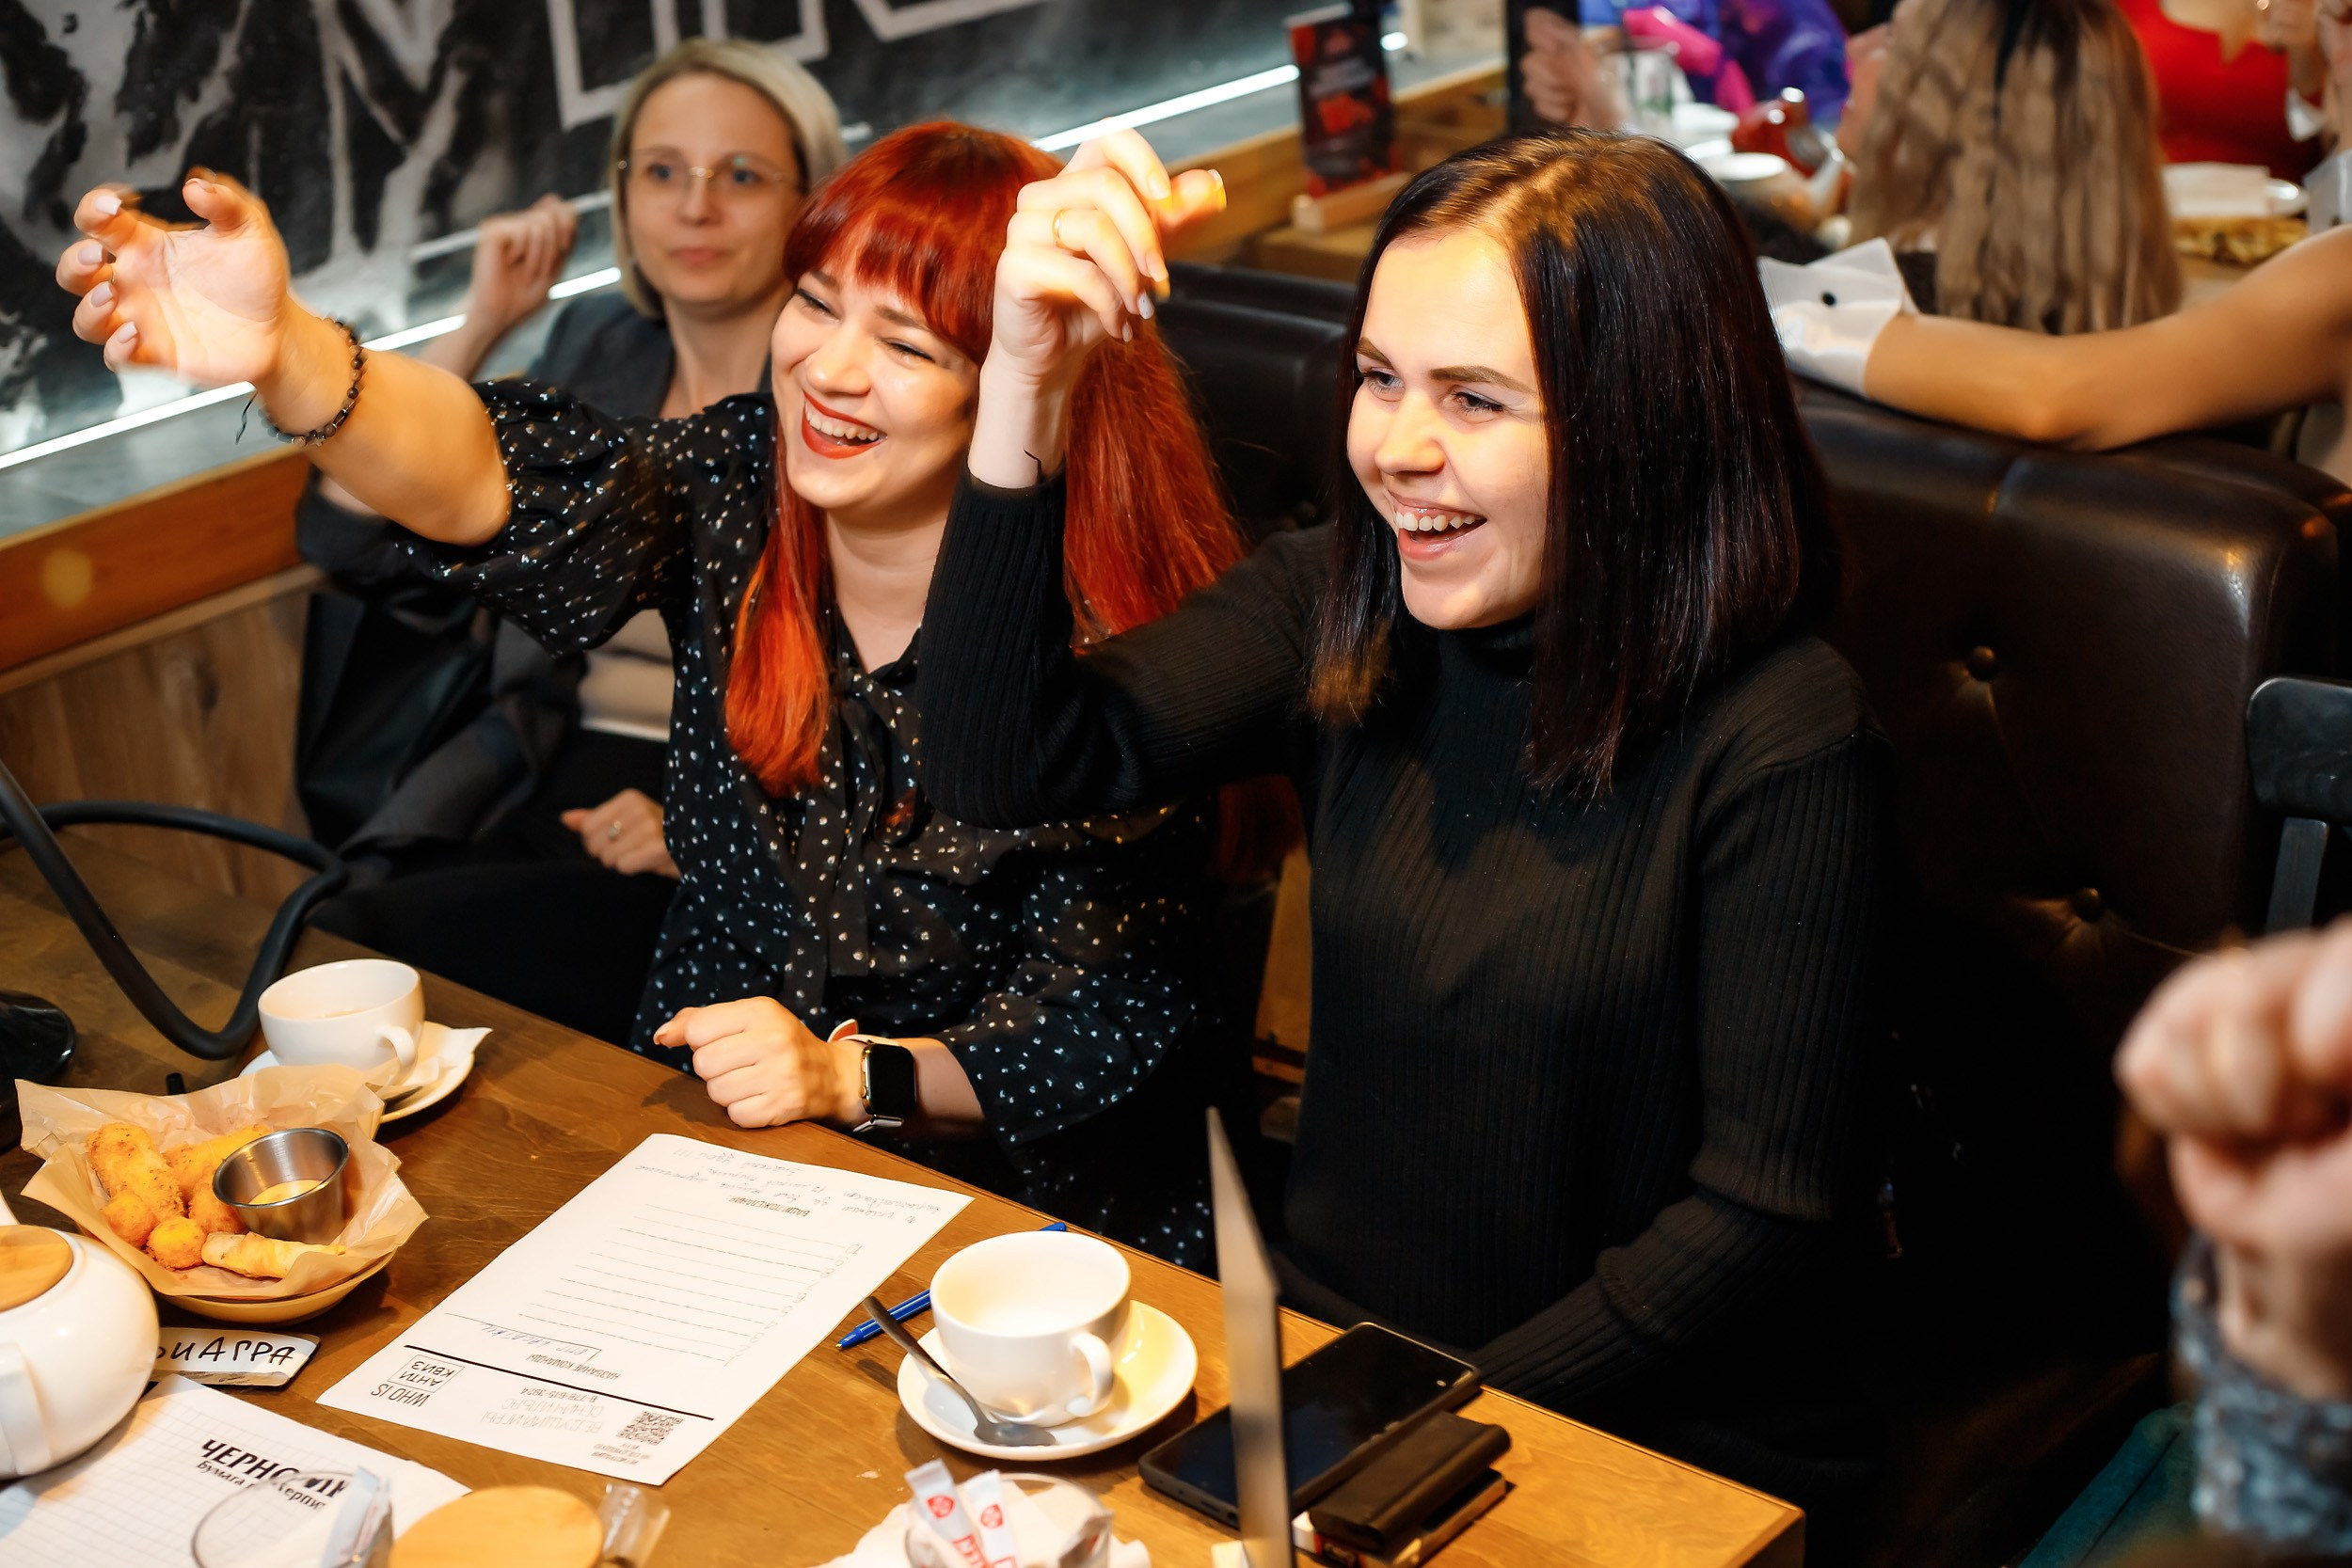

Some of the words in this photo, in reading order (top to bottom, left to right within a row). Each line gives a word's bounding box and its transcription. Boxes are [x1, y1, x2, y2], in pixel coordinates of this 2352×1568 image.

[779, 1205, 812, 1217] ВАШИ
[410, 1359, 456, 1376] КВИЗ
[526, 1354, 575, 1369] КОМАНДЫ
[399, 1370, 444, 1387] АНТИ
[571, 1364, 622, 1380] НАЗВАНИЕ
[370, 1383, 390, 1398] IS
[388, 1387, 431, 1407] WHO
[479, 1411, 524, 1425] ИГРЫ
[520, 1415, 603, 1433] ВЕДУЩИЙ
[196, 1460, 246, 1489] Бумага
